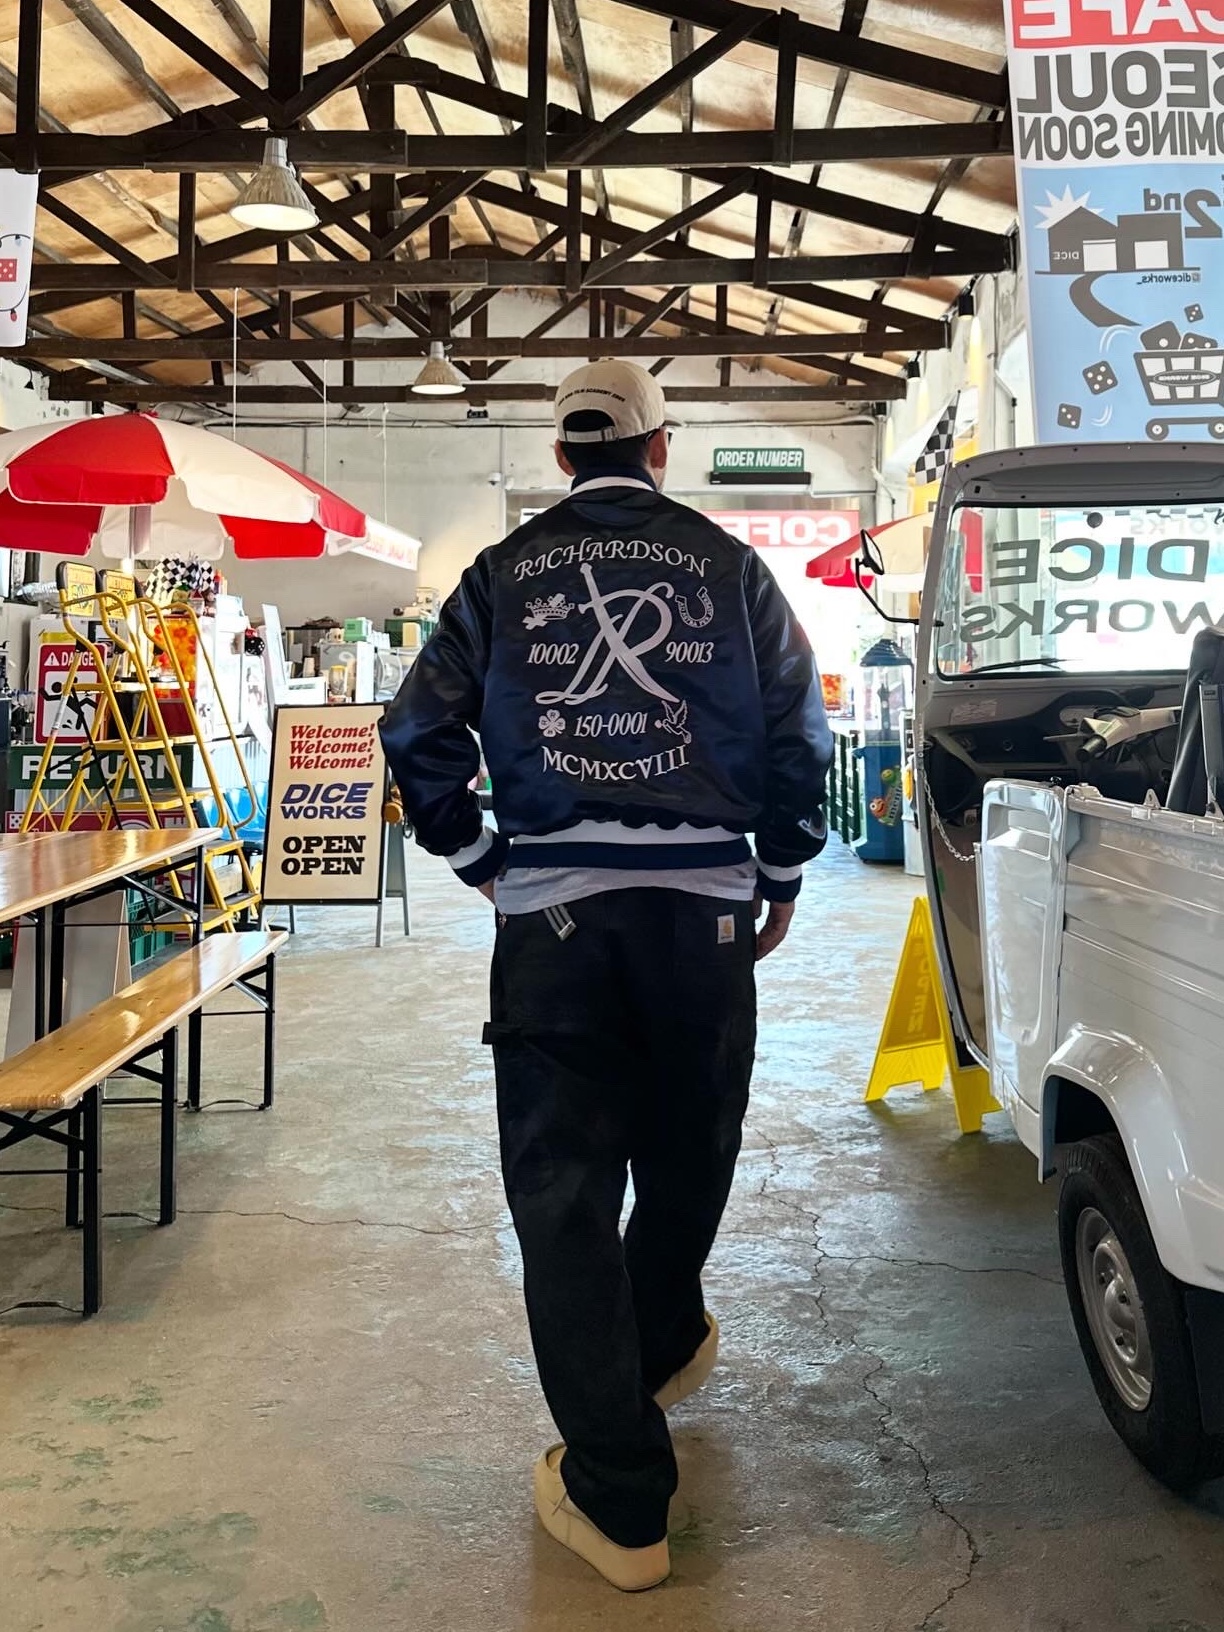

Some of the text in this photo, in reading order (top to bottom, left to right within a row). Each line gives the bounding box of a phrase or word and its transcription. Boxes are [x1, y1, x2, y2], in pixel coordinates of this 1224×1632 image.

[715, 450, 804, 467] ORDER NUMBER
[514, 537, 712, 582] RICHARDSON
[526, 642, 579, 665] 10002
[664, 641, 715, 664] 90013
[291, 723, 375, 739] Welcome!
[573, 711, 648, 738] 150-0001
[290, 739, 375, 755] Welcome!
[22, 754, 182, 780] RETURN
[289, 754, 374, 770] Welcome!
[541, 744, 690, 782] MCMXCVIII
[280, 782, 374, 805] DICE
[280, 805, 367, 820] WORKS
[282, 835, 367, 854] OPEN
[281, 857, 366, 876] OPEN
